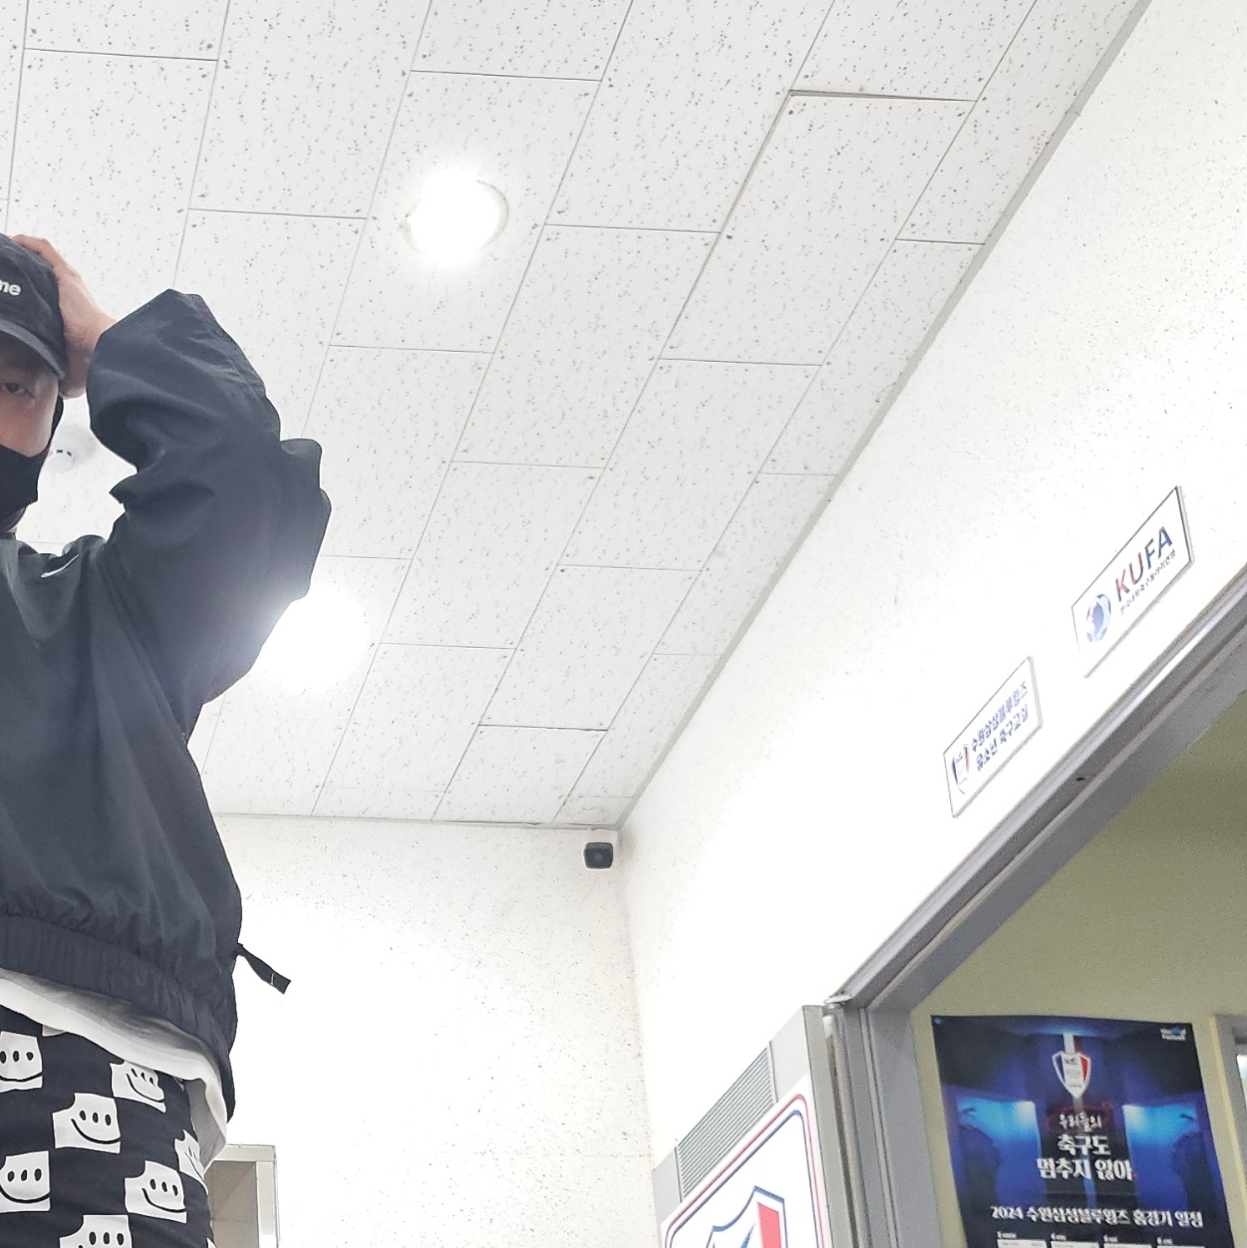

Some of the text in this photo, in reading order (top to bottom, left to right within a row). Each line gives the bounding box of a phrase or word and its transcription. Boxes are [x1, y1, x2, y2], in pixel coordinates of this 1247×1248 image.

[1115, 526, 1173, 602] KUFA
[1057, 1134, 1111, 1156] 축구도
[1036, 1157, 1092, 1180] 멈추지
[991, 1206, 1204, 1229] 2024 수원삼성블루윙즈 홈경기 일정
